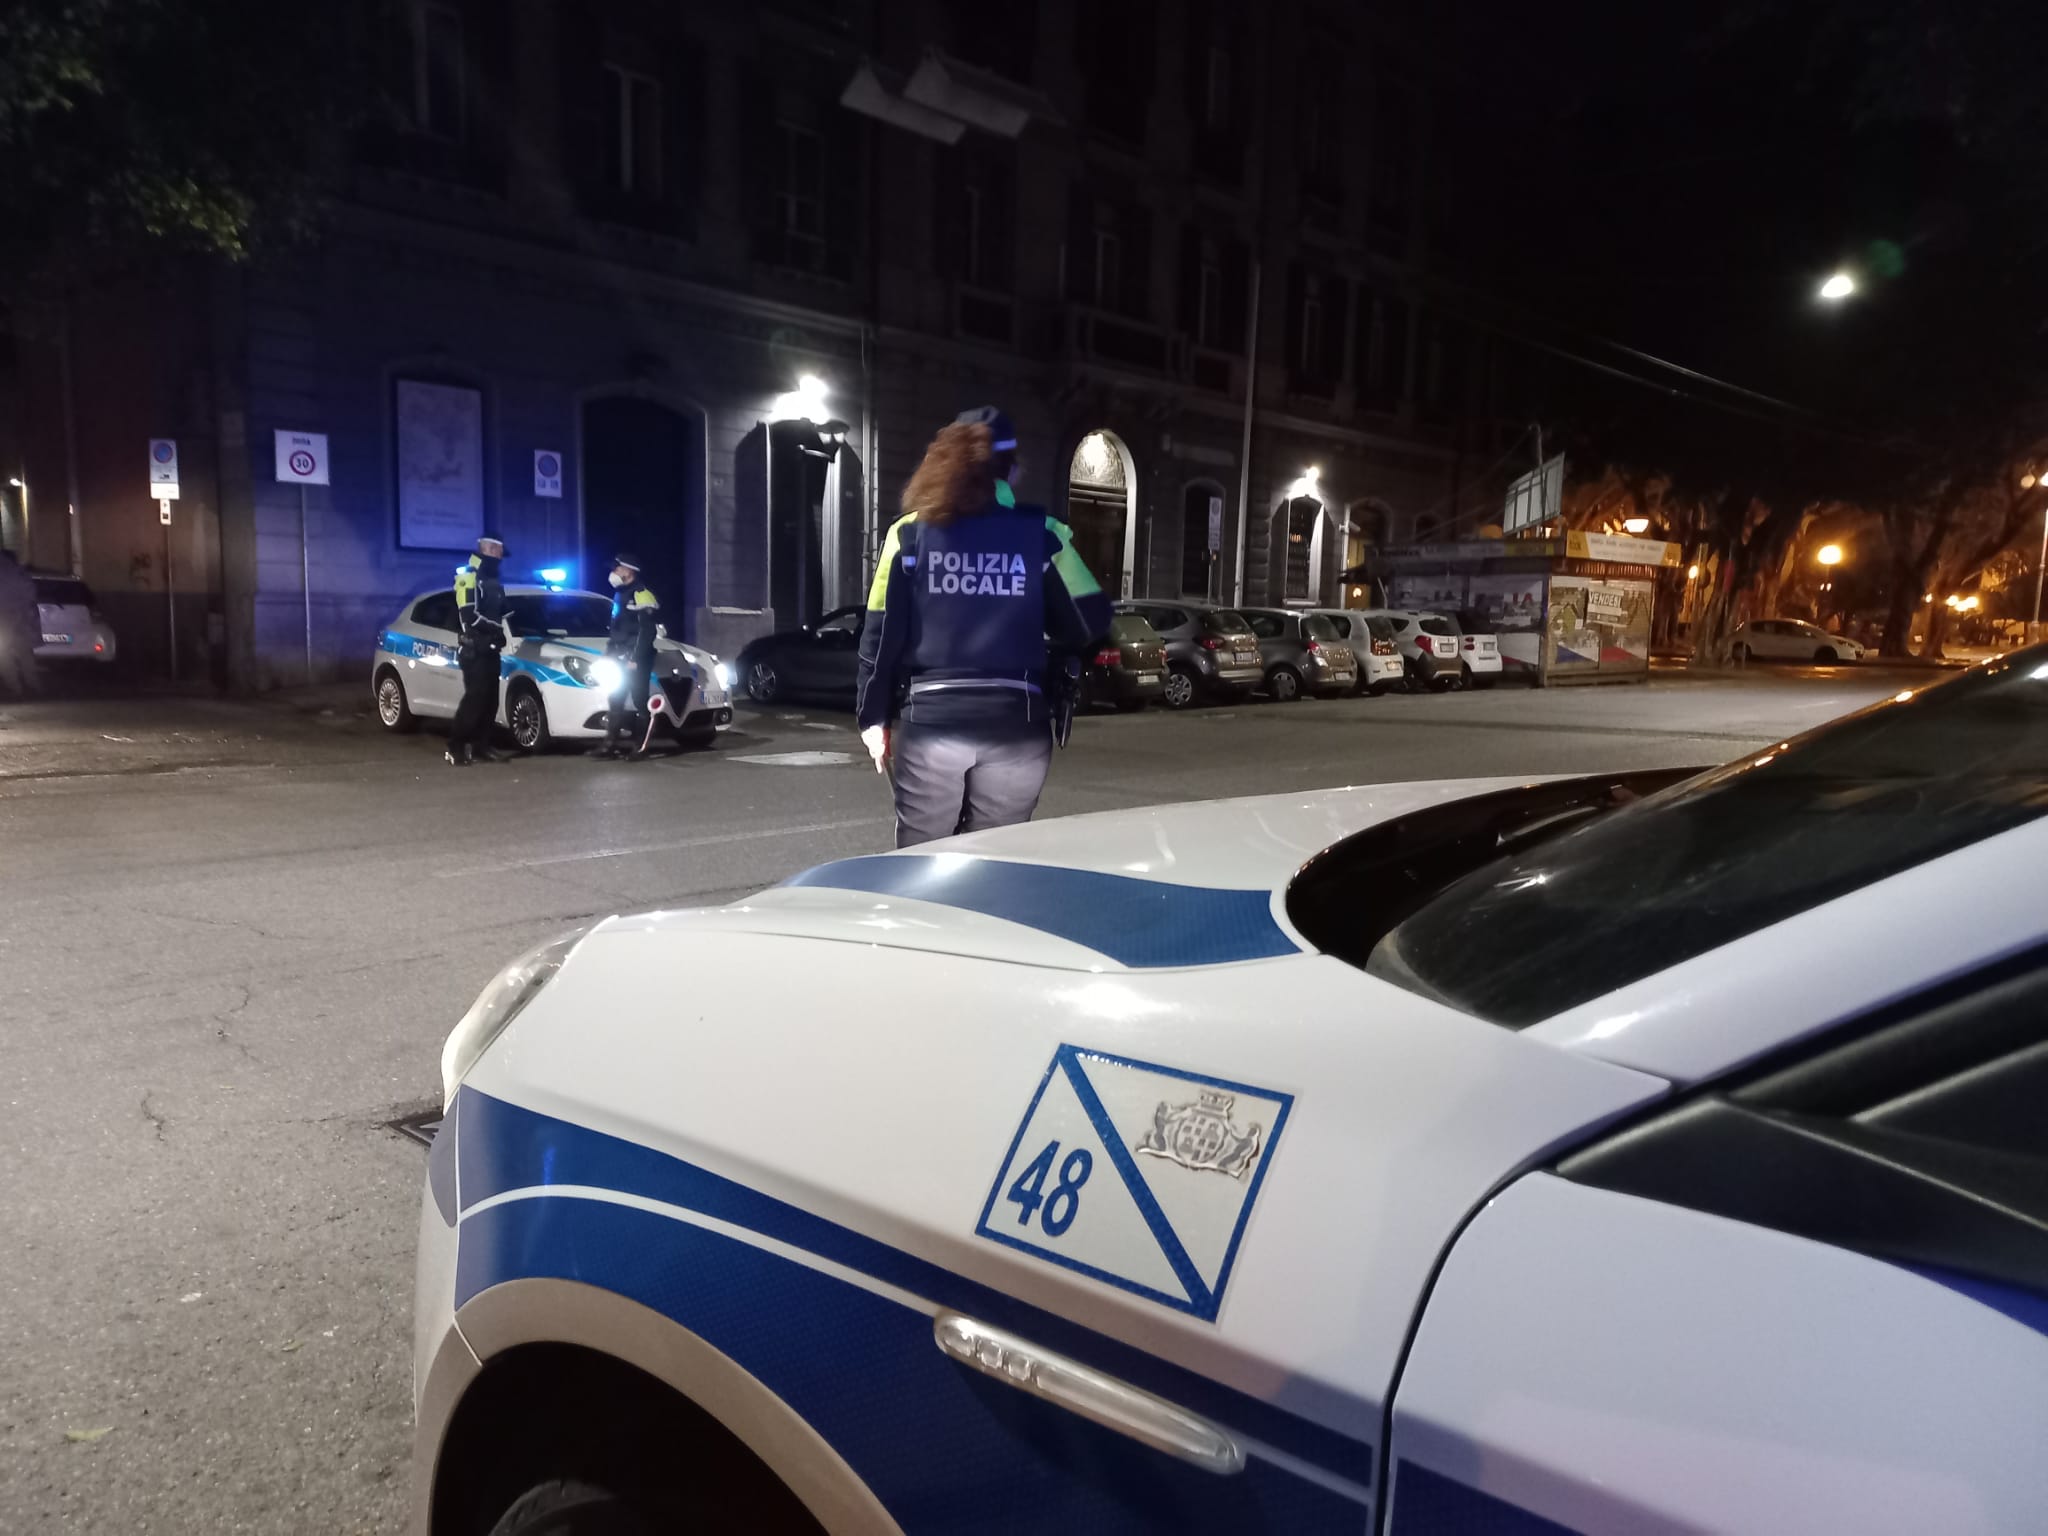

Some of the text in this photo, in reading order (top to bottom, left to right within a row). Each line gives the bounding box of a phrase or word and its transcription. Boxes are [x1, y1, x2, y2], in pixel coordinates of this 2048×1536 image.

[296, 457, 310, 469] 30
[928, 551, 1026, 575] POLIZIA
[928, 573, 1026, 596] LOCALE
[1589, 591, 1621, 608] VENDESI
[1006, 1140, 1093, 1237] 48
